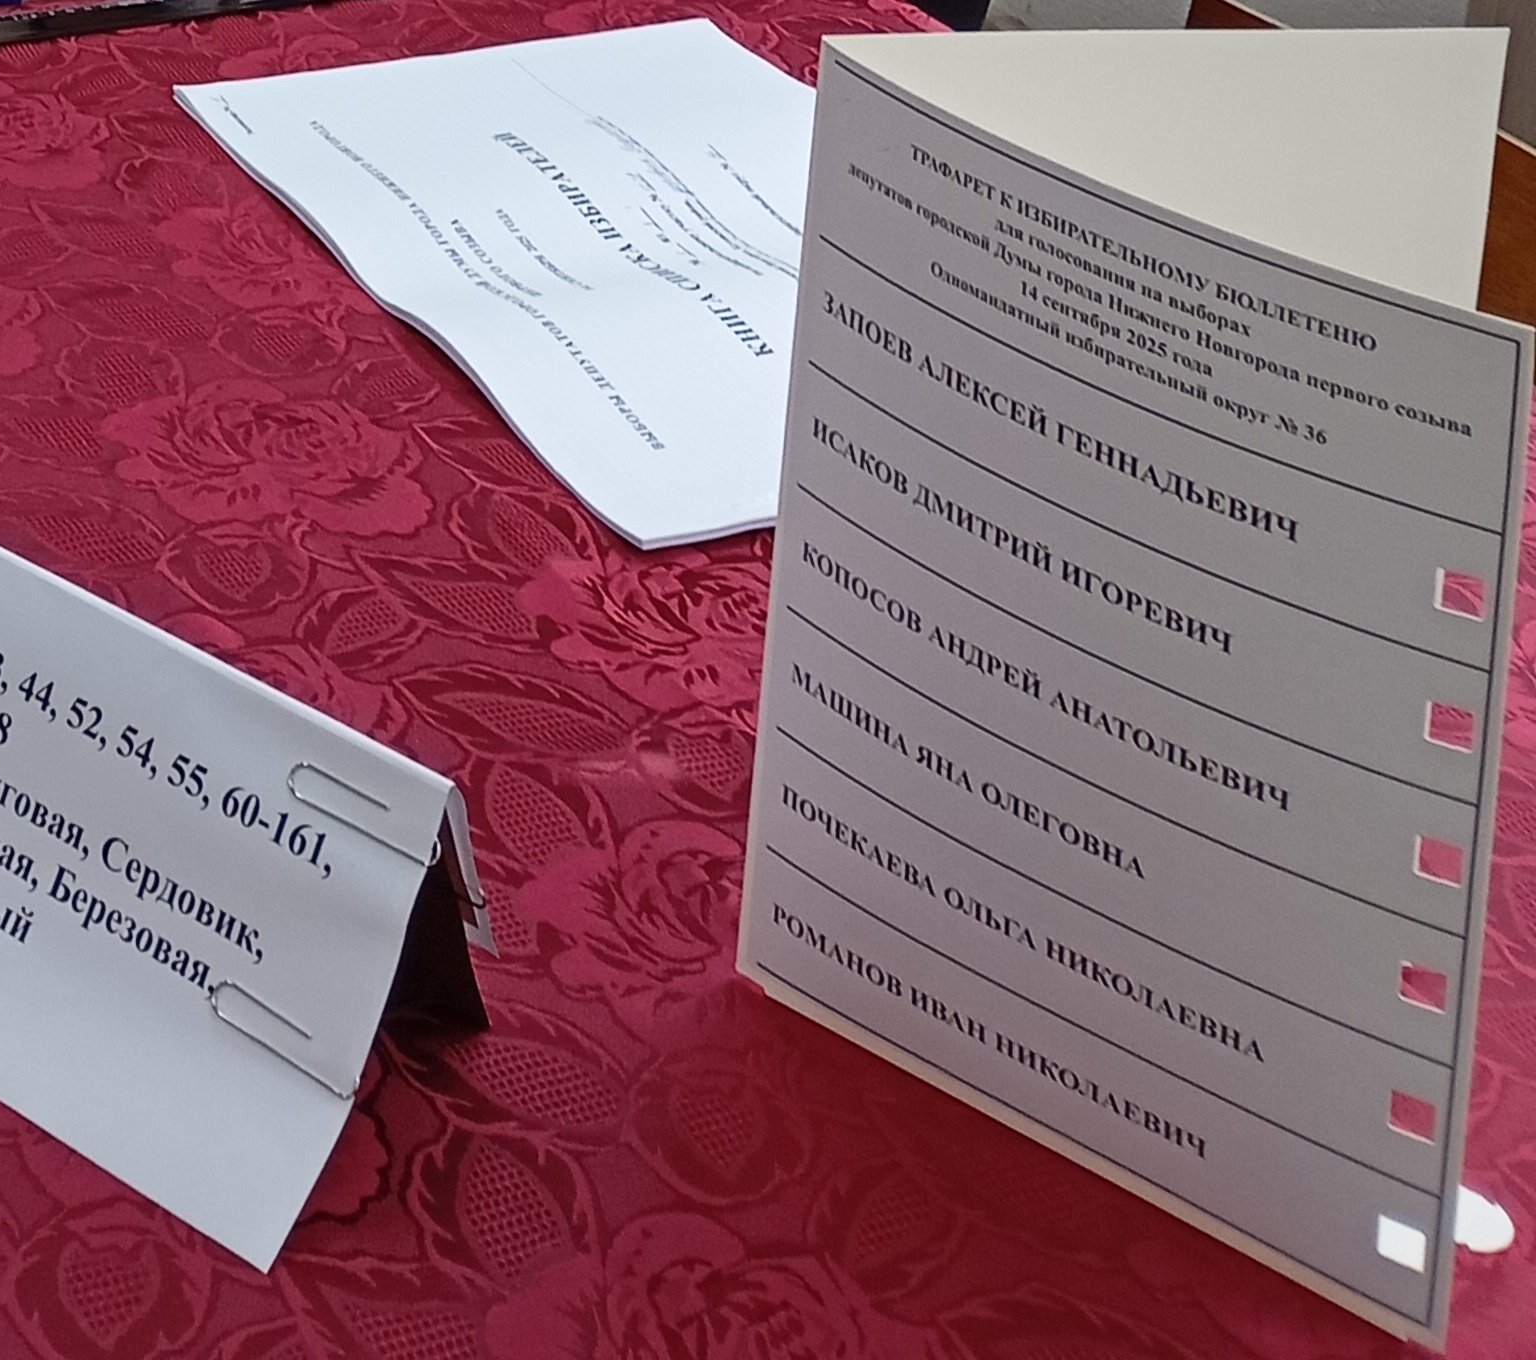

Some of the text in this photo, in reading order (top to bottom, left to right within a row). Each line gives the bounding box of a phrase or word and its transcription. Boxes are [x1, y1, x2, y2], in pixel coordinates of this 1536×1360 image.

[409, 202, 448, 246] ГОРОДА
[451, 218, 492, 264] СОЗЫВА
[492, 131, 623, 241] ИЗБИРАТЕЛЕЙ
[911, 143, 1378, 353] ТРАФАРЕТ К ИЗБИРАТЕЛЬНОМУ БЮЛЛЕТЕНЮ
[618, 242, 701, 291] СПИСКА
[700, 292, 774, 357] КНИГА
[848, 163, 913, 211] депутатов
[916, 204, 991, 252] городской
[993, 242, 1042, 277] Думы
[1046, 270, 1103, 306] города
[1108, 293, 1190, 340] Нижнего
[1196, 328, 1300, 382] Новгорода
[1307, 373, 1389, 411] первого
[1395, 401, 1472, 437] созыва
[994, 219, 1252, 338] для голосования на выборах
[1019, 281, 1213, 378] 14 сентября 2025 года
[541, 319, 616, 393] ДЕПУТАТОВ
[823, 291, 1300, 543] ЗАПОЕВ АЛЕКСЕЙ ГЕННАДЬЕВИЧ
[930, 260, 1327, 446] Одномандатный избирательный округ № 36
[608, 394, 665, 451] ВЫБОРЫ
[813, 417, 1234, 655] ИСАКОВ ДМИТРИЙ ИГОРЕВИЧ
[801, 541, 1291, 812] КОПОСОВ АНДРЕЙ АНАТОЛЬЕВИЧ
[17, 672, 57, 723] 44,
[65, 697, 107, 751] 52,
[115, 724, 157, 780] 54,
[167, 753, 210, 810] 55,
[221, 786, 332, 879] 60-161,
[791, 663, 1145, 880] МАШИНА ЯНА ОЛЕГОВНА
[46, 864, 215, 999] Березовая,
[100, 836, 263, 965] Сердовик,
[781, 784, 1265, 1063] ПОЧЕКАЕВА ОЛЬГА НИКОЛАЕВНА
[772, 903, 1208, 1160] РОМАНОВ ИВАН НИКОЛАЕВИЧ
